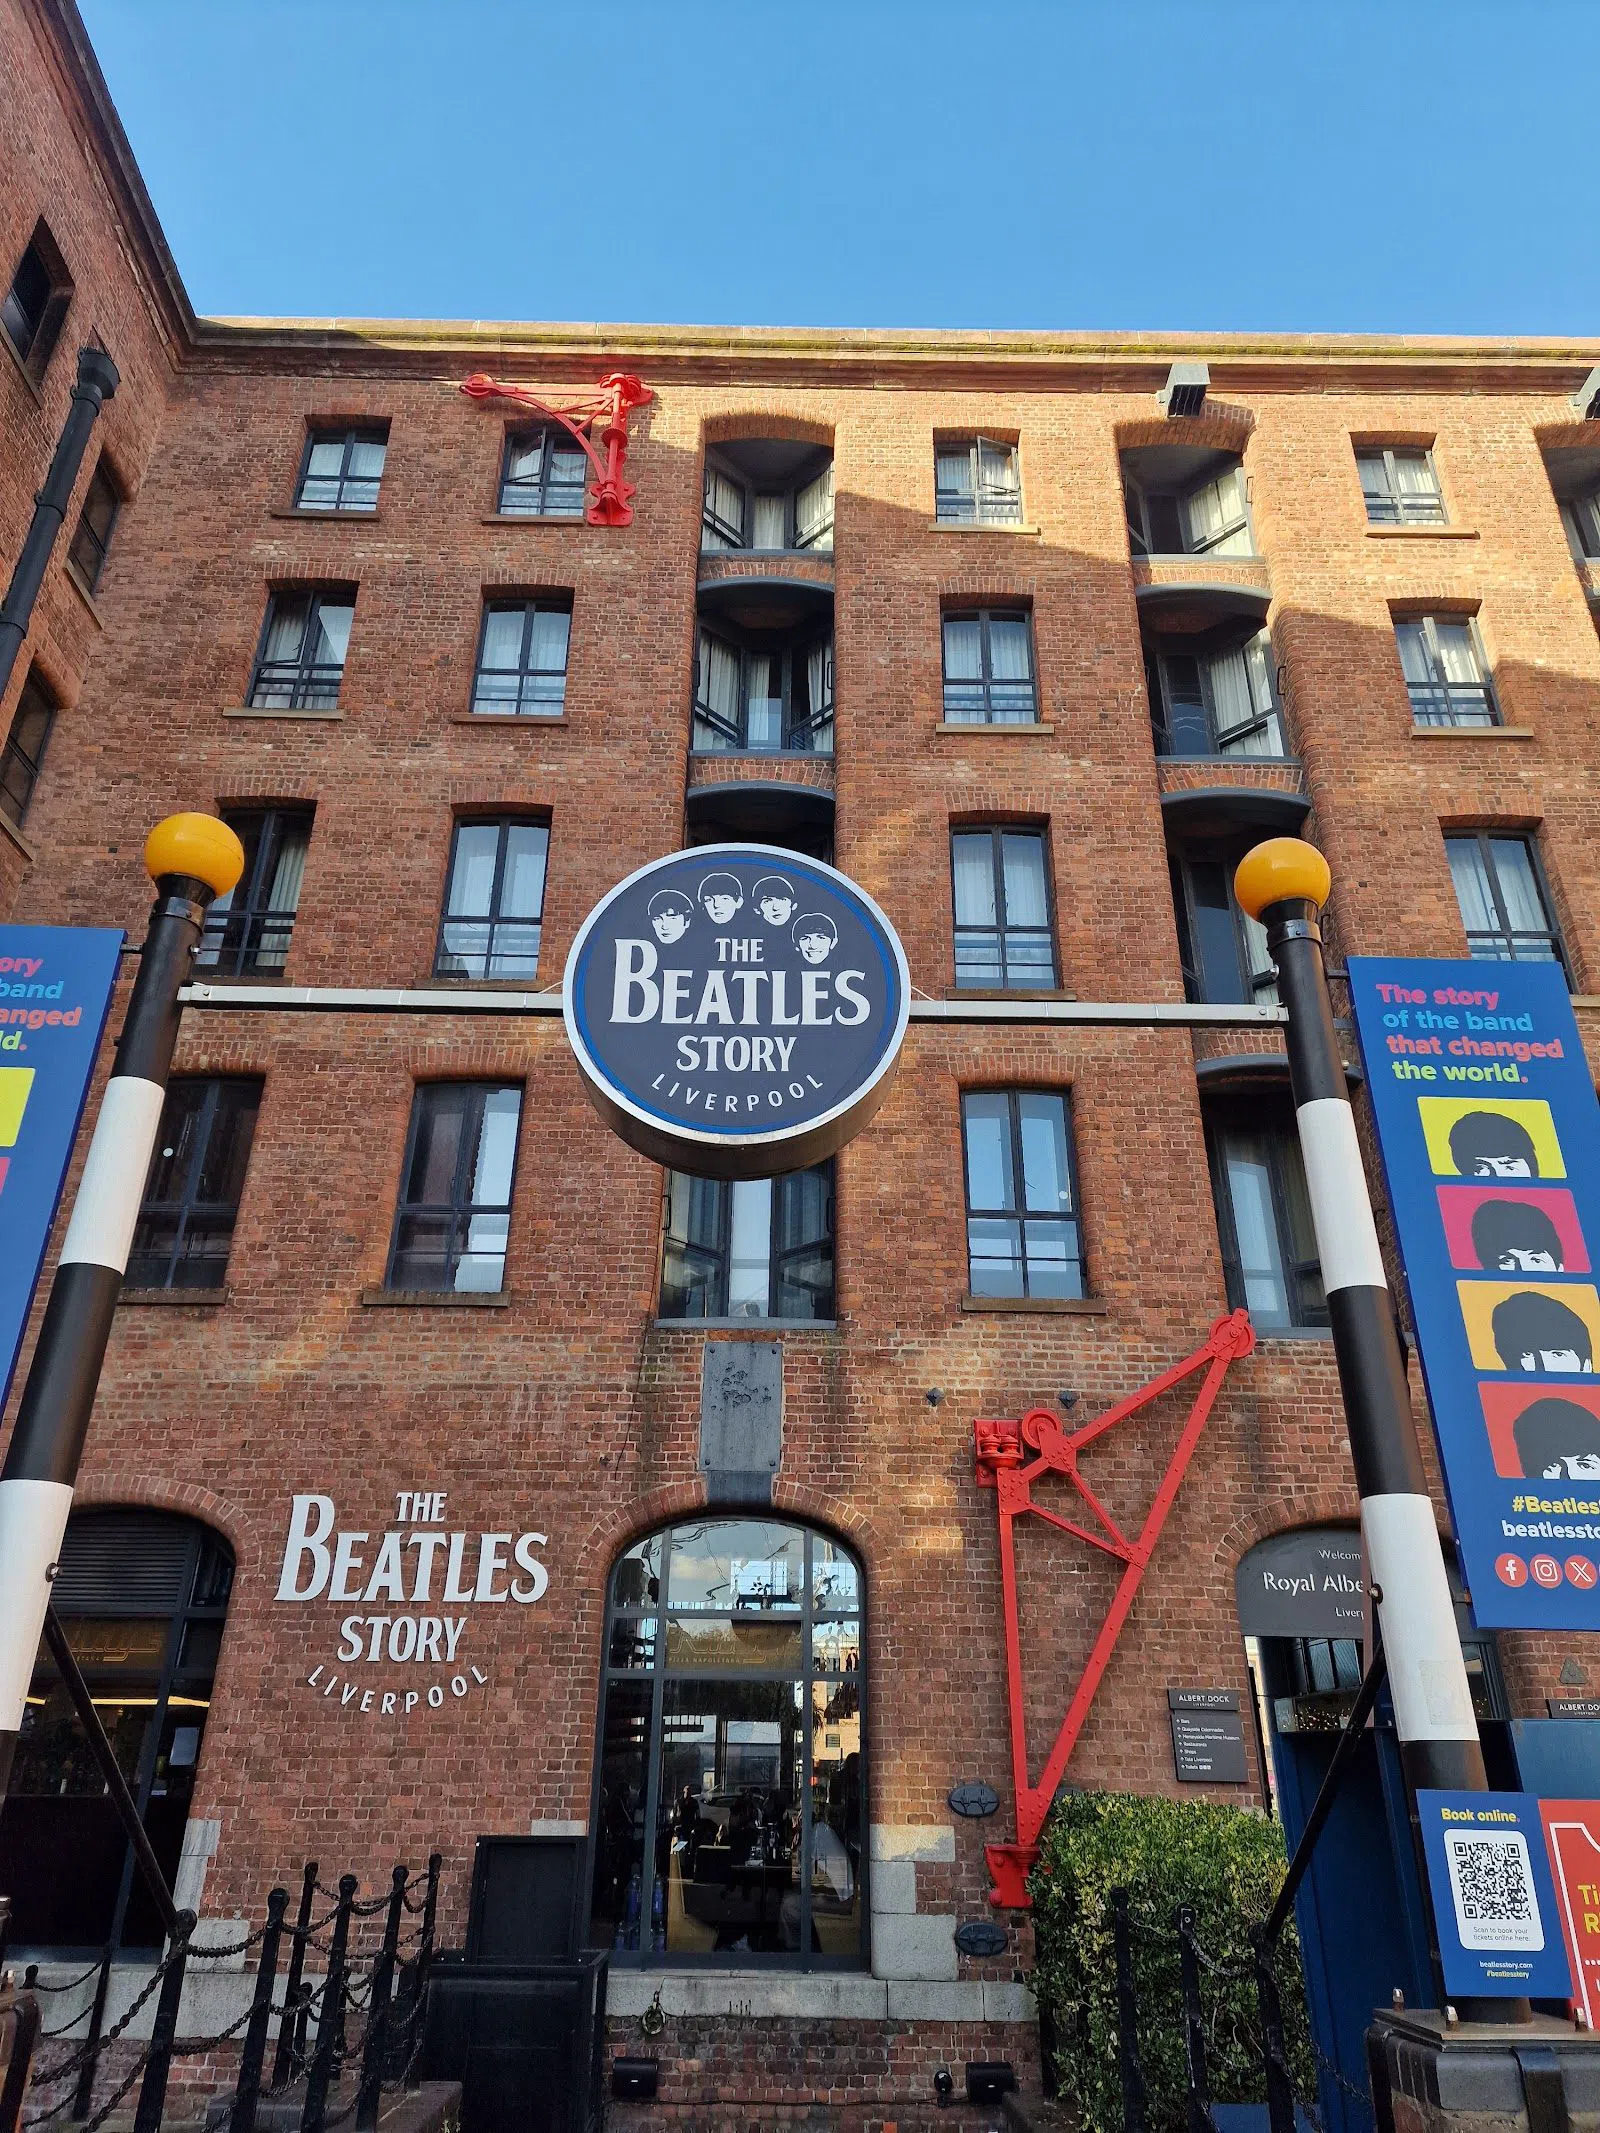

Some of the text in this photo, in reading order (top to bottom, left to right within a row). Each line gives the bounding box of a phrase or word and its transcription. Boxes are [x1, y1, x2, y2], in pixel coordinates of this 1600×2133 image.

[714, 938, 764, 962] THE
[608, 938, 871, 1026] BEATLES
[1376, 984, 1499, 1011] The story
[1383, 1010, 1533, 1032] of the band
[676, 1036, 797, 1072] STORY
[1386, 1035, 1564, 1062] that changed
[1392, 1060, 1528, 1084] the world.
[651, 1073, 823, 1113] LIVERPOOL
[396, 1492, 447, 1522] THE
[1512, 1495, 1600, 1515] #Beatles
[273, 1494, 549, 1603] BEATLES
[1319, 1549, 1362, 1560] Welcom
[1263, 1572, 1364, 1597] Royal Albe
[337, 1616, 468, 1662] STORY
[307, 1665, 488, 1714] LIVERPOOL
[1208, 1695, 1230, 1703] DOCK
[1441, 1808, 1520, 1823] Book online.
[1479, 1960, 1533, 1969] beatlesstory.com
